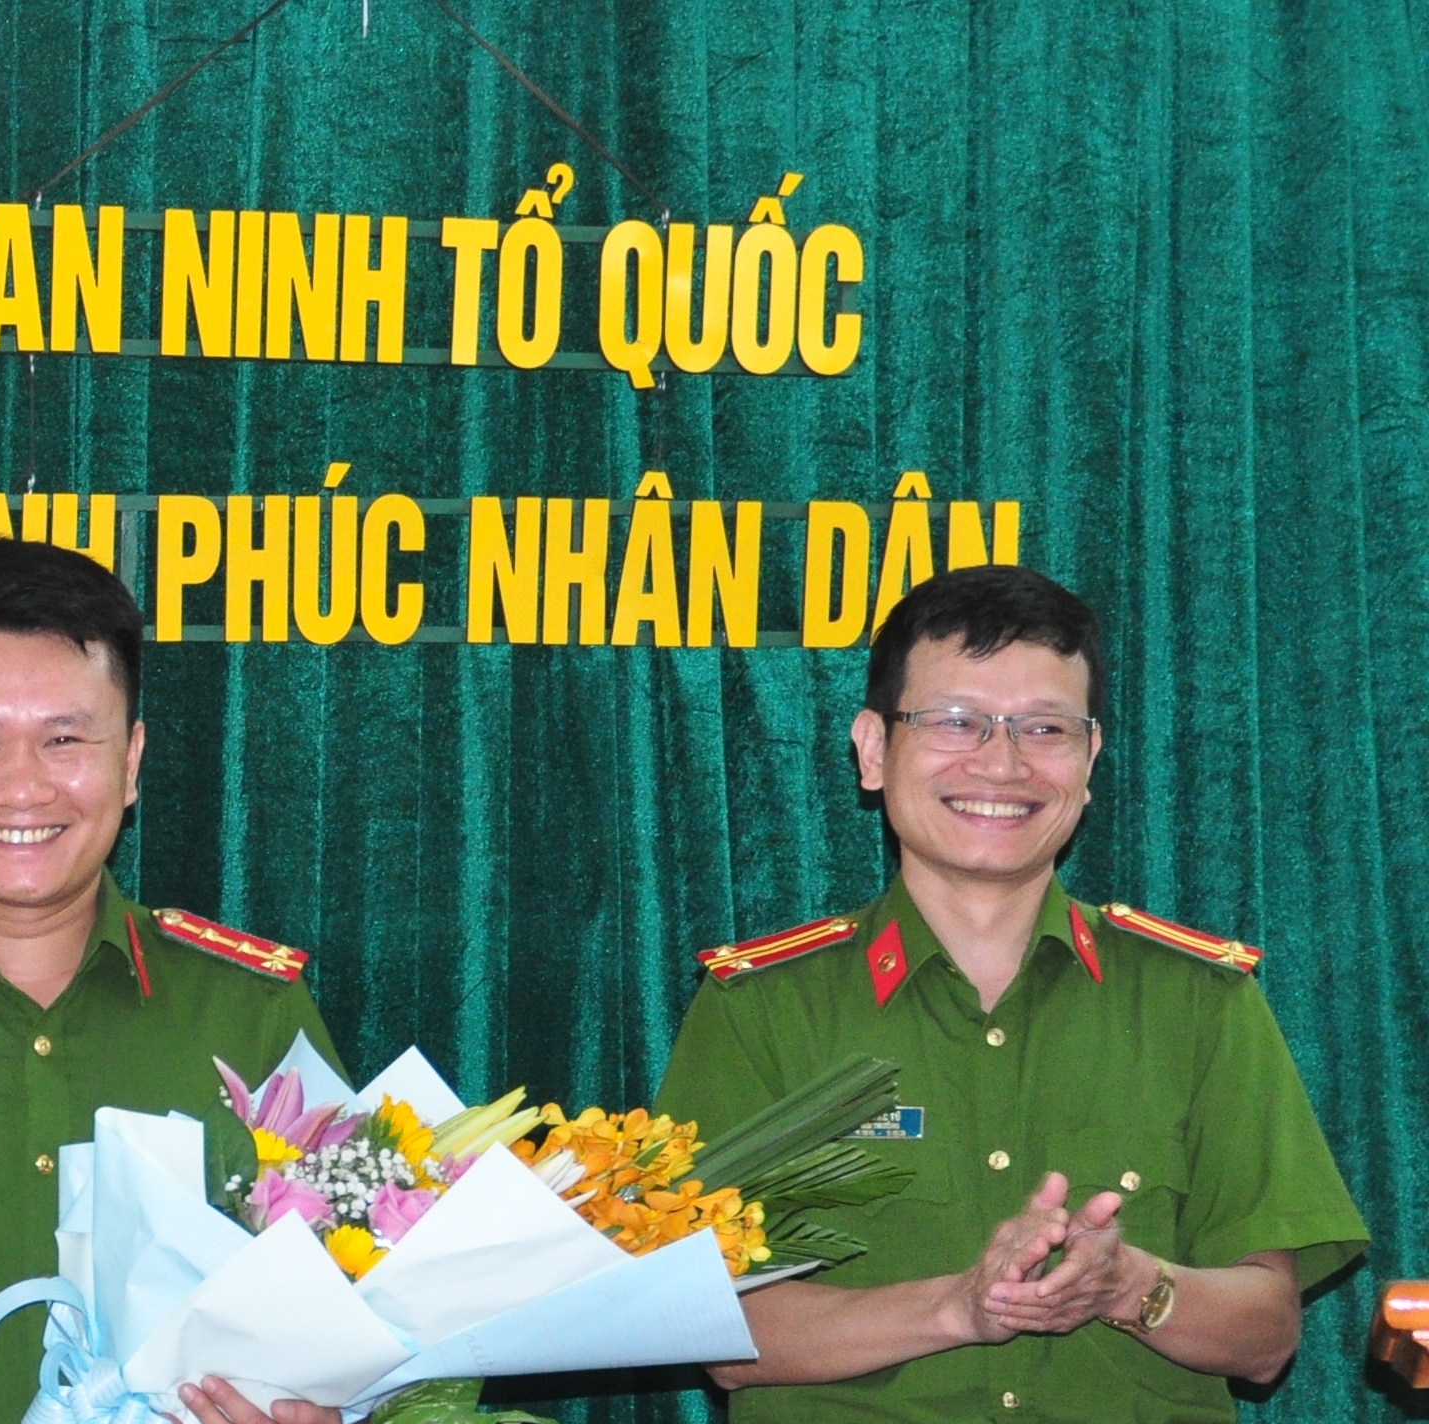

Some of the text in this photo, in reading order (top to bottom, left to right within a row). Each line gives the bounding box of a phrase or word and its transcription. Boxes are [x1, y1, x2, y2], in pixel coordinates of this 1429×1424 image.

[163, 210, 407, 363] NINH
[444, 164, 573, 368] TỔ
[601, 174, 863, 388] QUỐC
[158, 462, 424, 645] PHÚC
[469, 472, 761, 648] NHÂN
